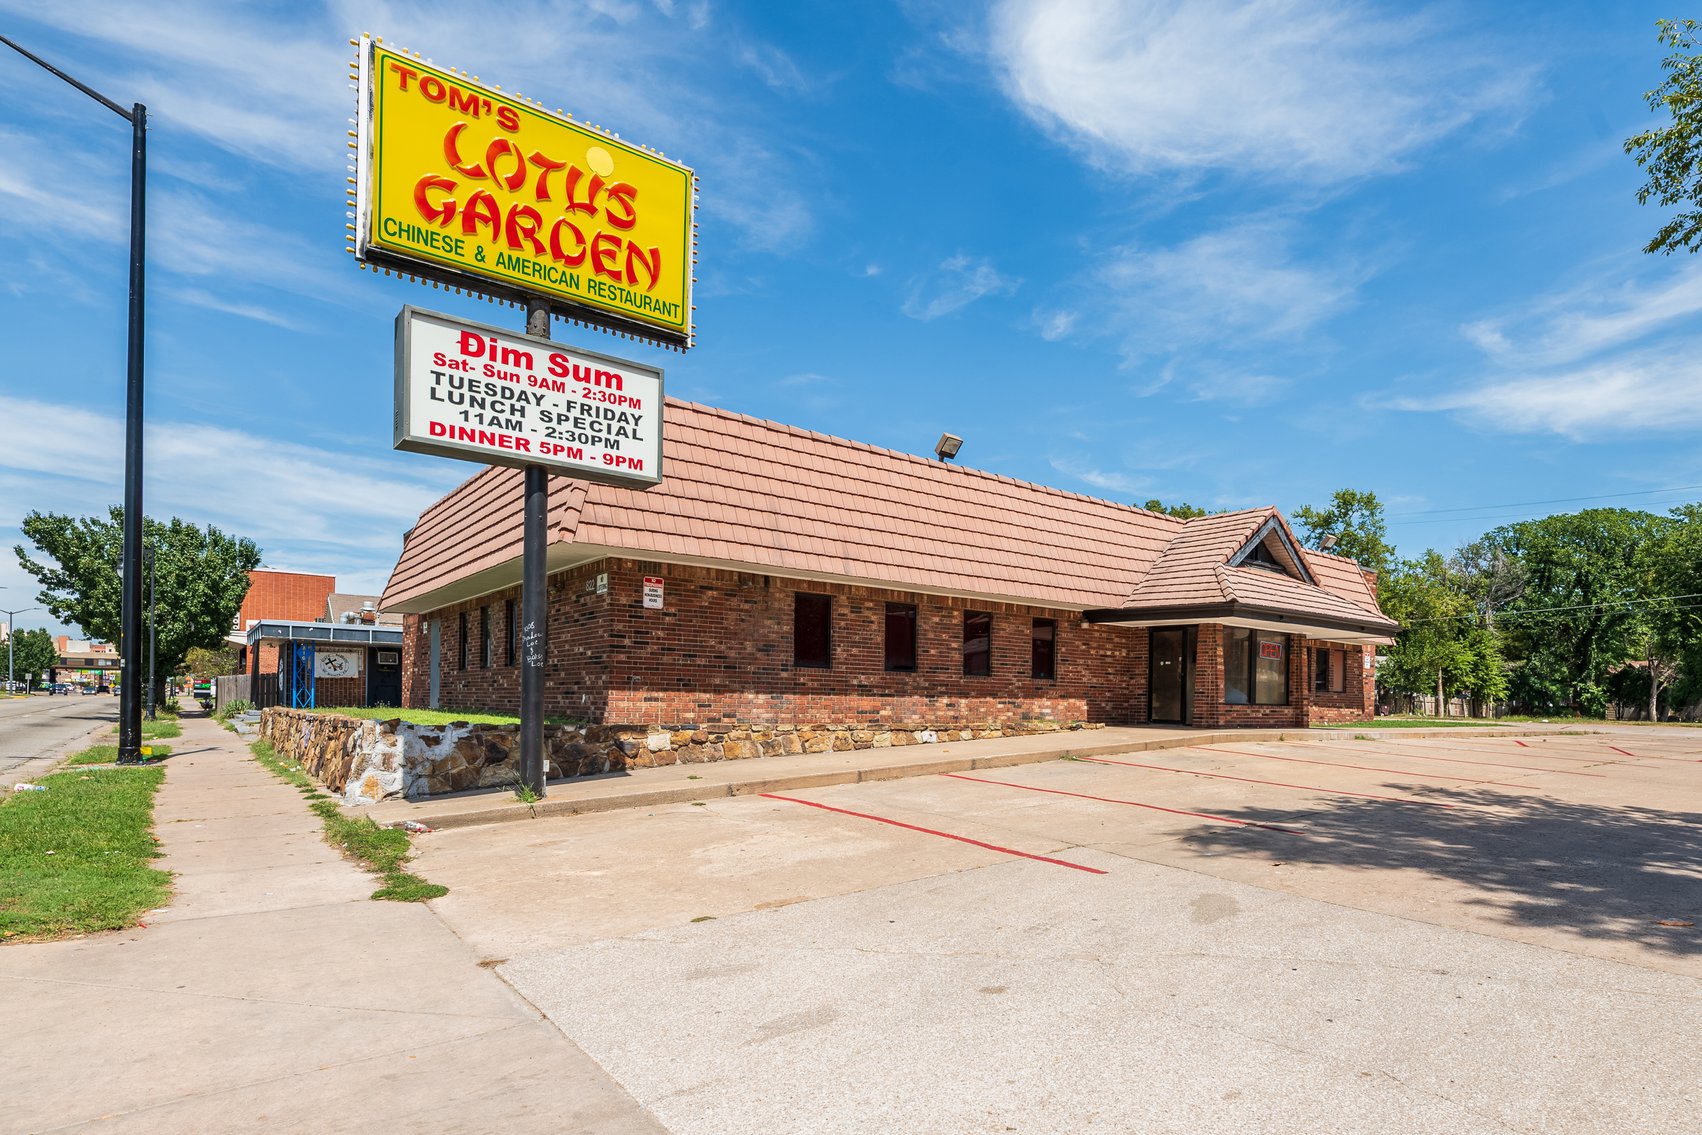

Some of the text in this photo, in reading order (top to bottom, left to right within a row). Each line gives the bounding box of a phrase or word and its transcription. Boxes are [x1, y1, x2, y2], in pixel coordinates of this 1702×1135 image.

[390, 61, 521, 132] TOM'S
[443, 120, 638, 230] LOTUS
[413, 173, 661, 291] GARDEN
[383, 216, 681, 319] CHINESE & AMERICAN RESTAURANT
[430, 370, 546, 407] TUESDAY
[566, 401, 644, 427] FRIDAY
[483, 363, 521, 384] Sun
[528, 375, 566, 394] 9AM
[582, 387, 642, 410] 2:30PM
[547, 353, 624, 391] Sum
[430, 387, 644, 442] LUNCH SPECIAL
[459, 410, 523, 433] 11AM
[544, 426, 620, 451] 2:30PM
[429, 421, 531, 453] DINNER
[539, 442, 583, 461] 5PM
[603, 453, 644, 472] 9PM
